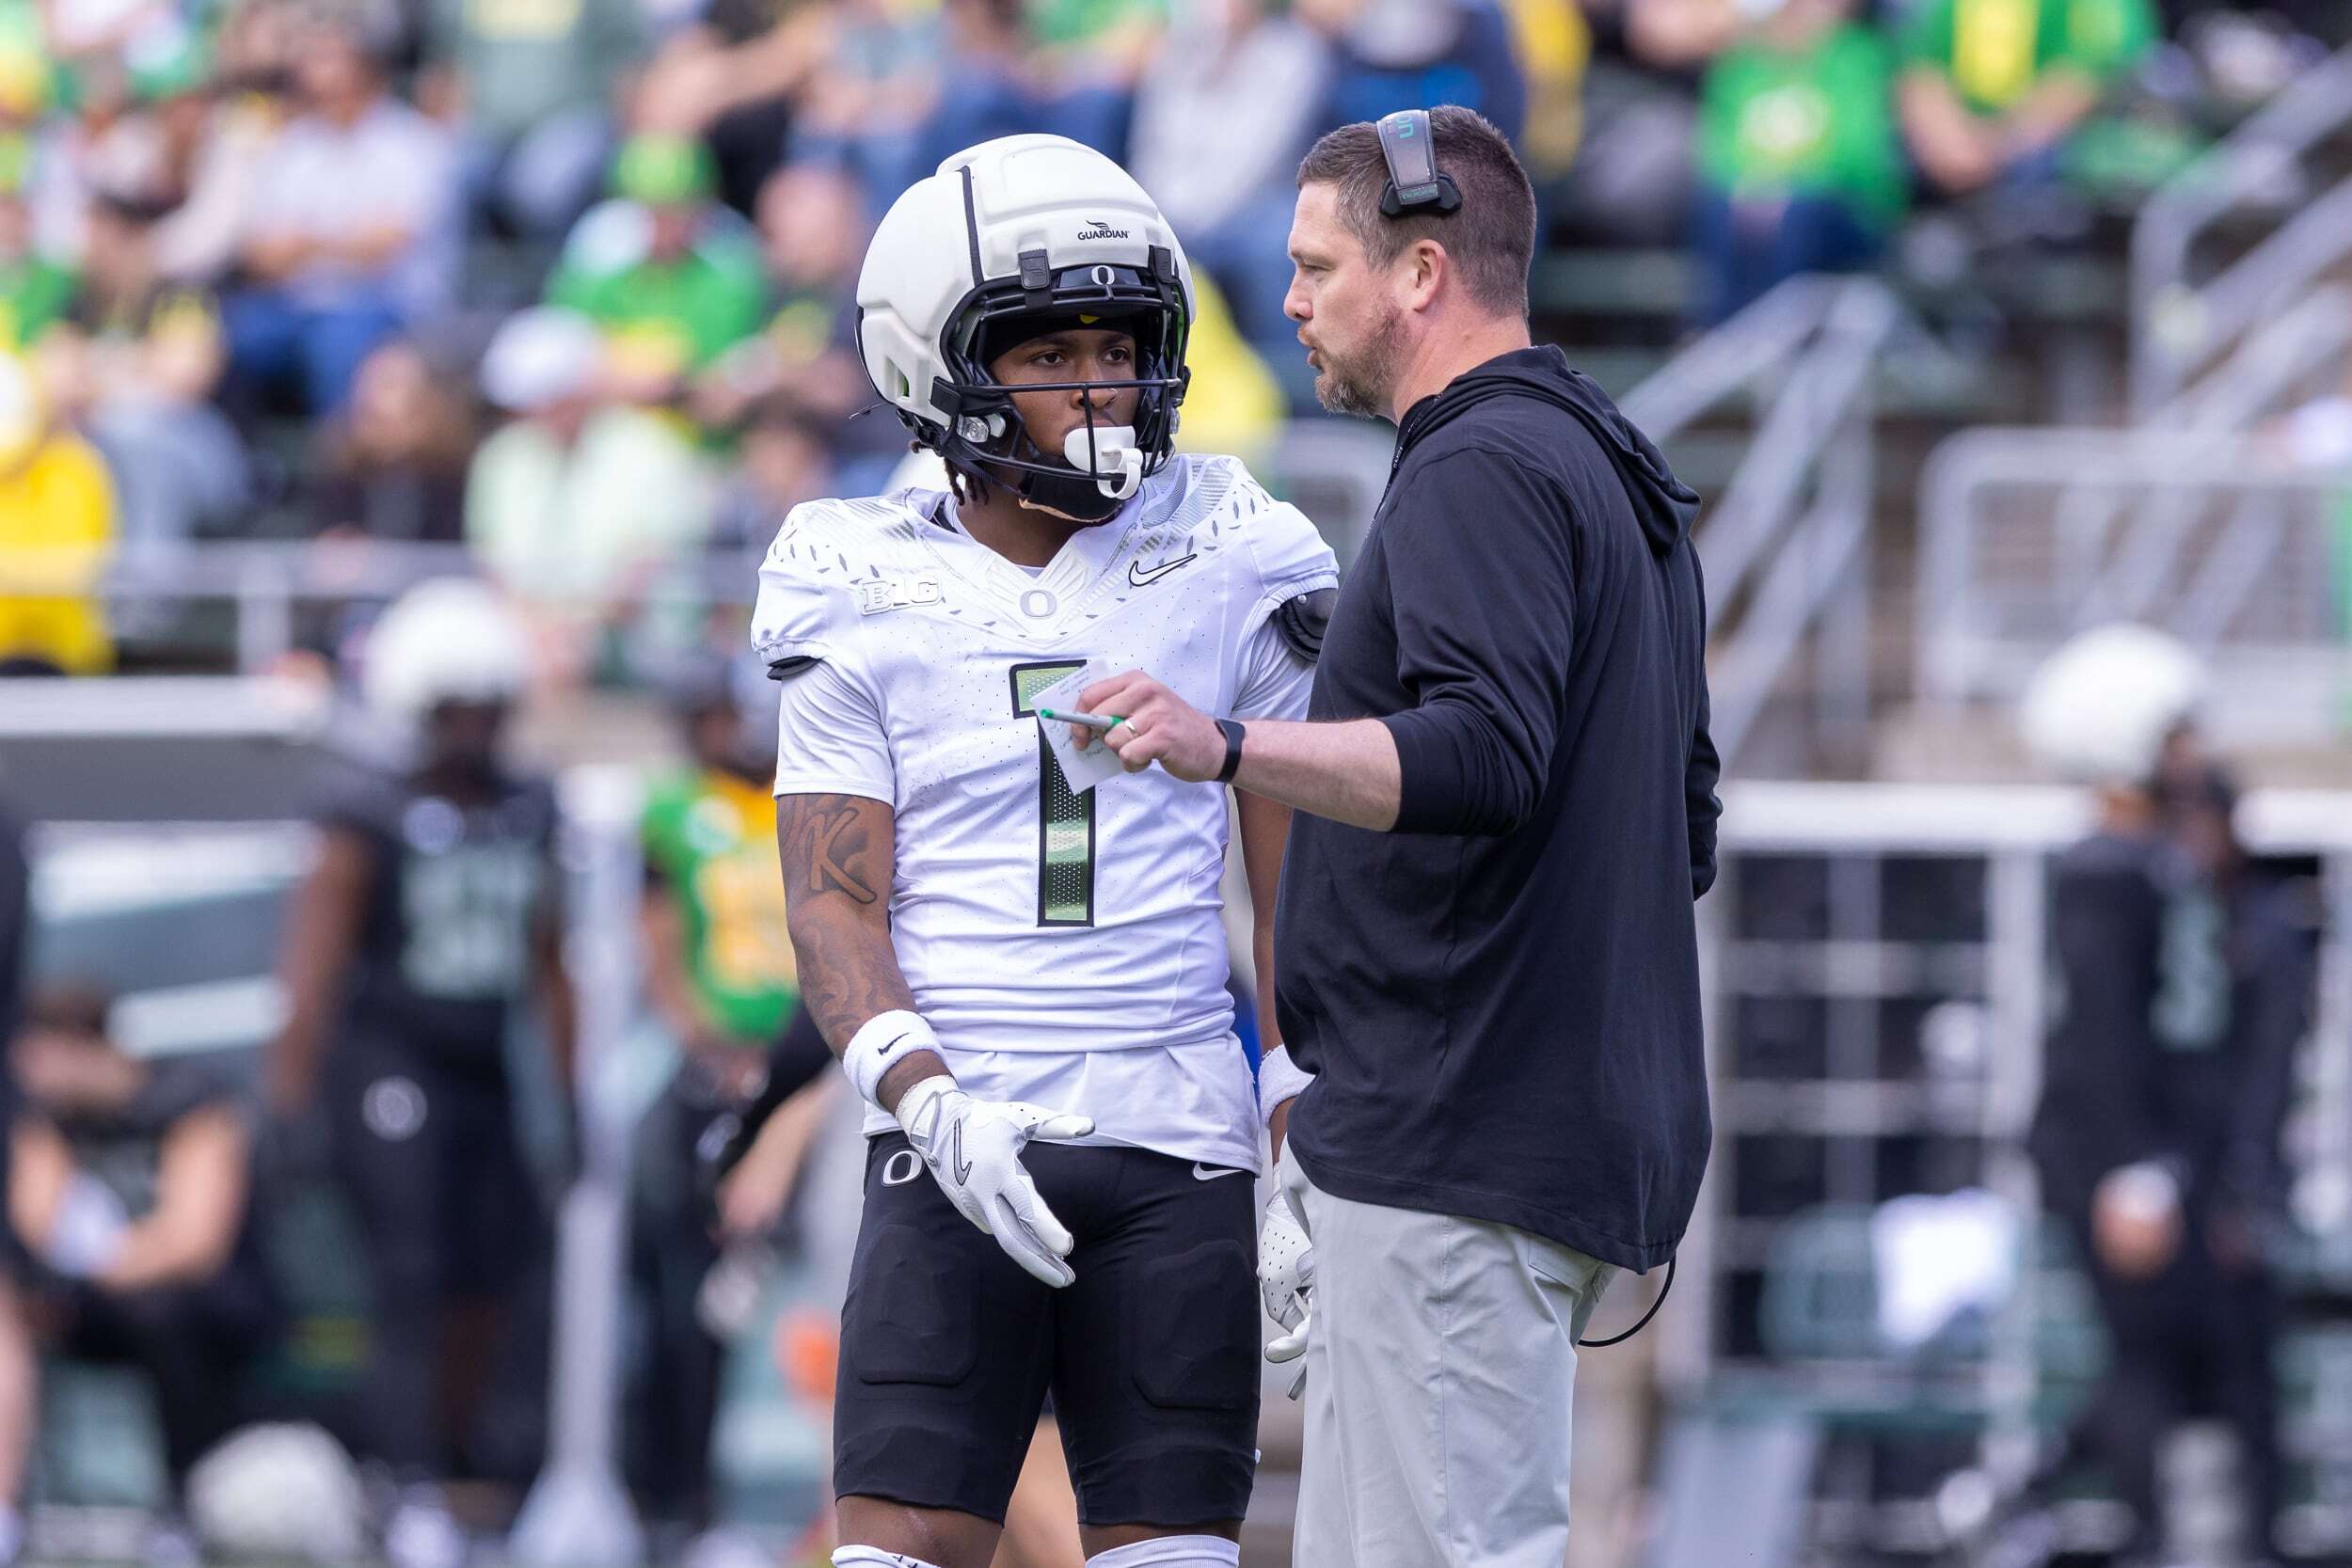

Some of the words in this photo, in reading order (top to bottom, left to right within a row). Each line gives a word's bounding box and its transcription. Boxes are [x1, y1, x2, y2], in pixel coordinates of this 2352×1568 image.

[1077, 230, 1129, 241] GUARDIAN
[1020, 589, 1057, 617] O
[1009, 659, 1096, 927] 1
[882, 1151, 925, 1188] O
